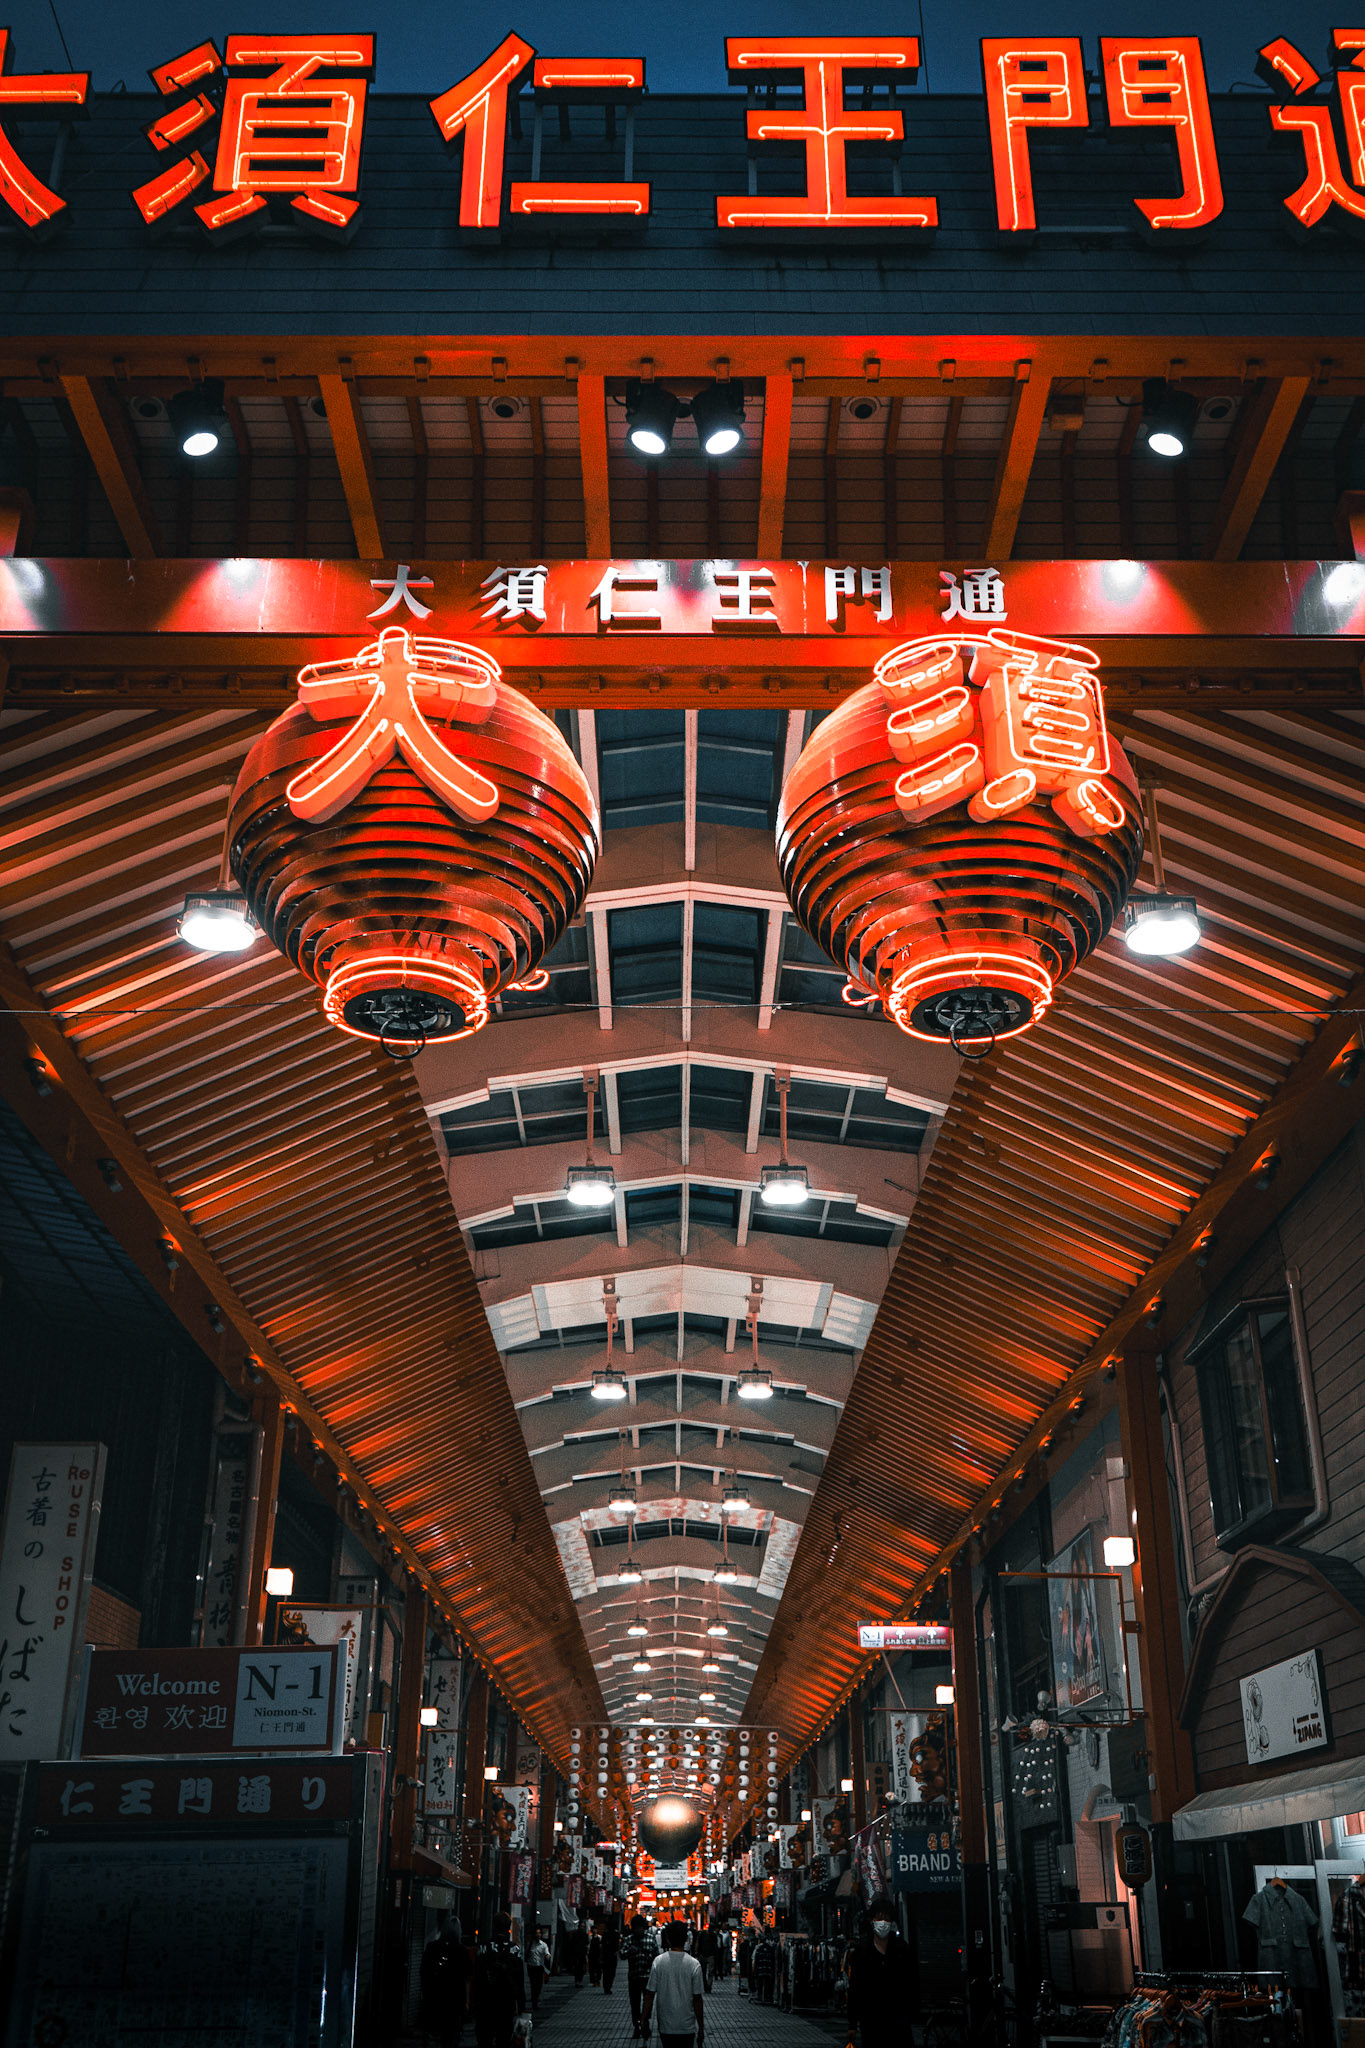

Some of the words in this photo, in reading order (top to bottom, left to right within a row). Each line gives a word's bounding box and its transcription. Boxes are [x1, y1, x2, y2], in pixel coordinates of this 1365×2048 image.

[366, 564, 1008, 627] 大須仁王門通
[286, 626, 500, 822] 大
[878, 628, 1126, 836] 須
[53, 1557, 73, 1630] SHOP
[115, 1672, 221, 1697] Welcome
[243, 1665, 324, 1700] N-1
[92, 1705, 149, 1730] 환영
[163, 1704, 227, 1731] 欢迎
[254, 1707, 317, 1718] Niomon-St.
[259, 1722, 306, 1733] 仁王門通
[894, 1719, 909, 1800] 大須仁王門通り
[60, 1774, 328, 1817] 仁王門通り
[899, 1853, 951, 1872] BRAND
